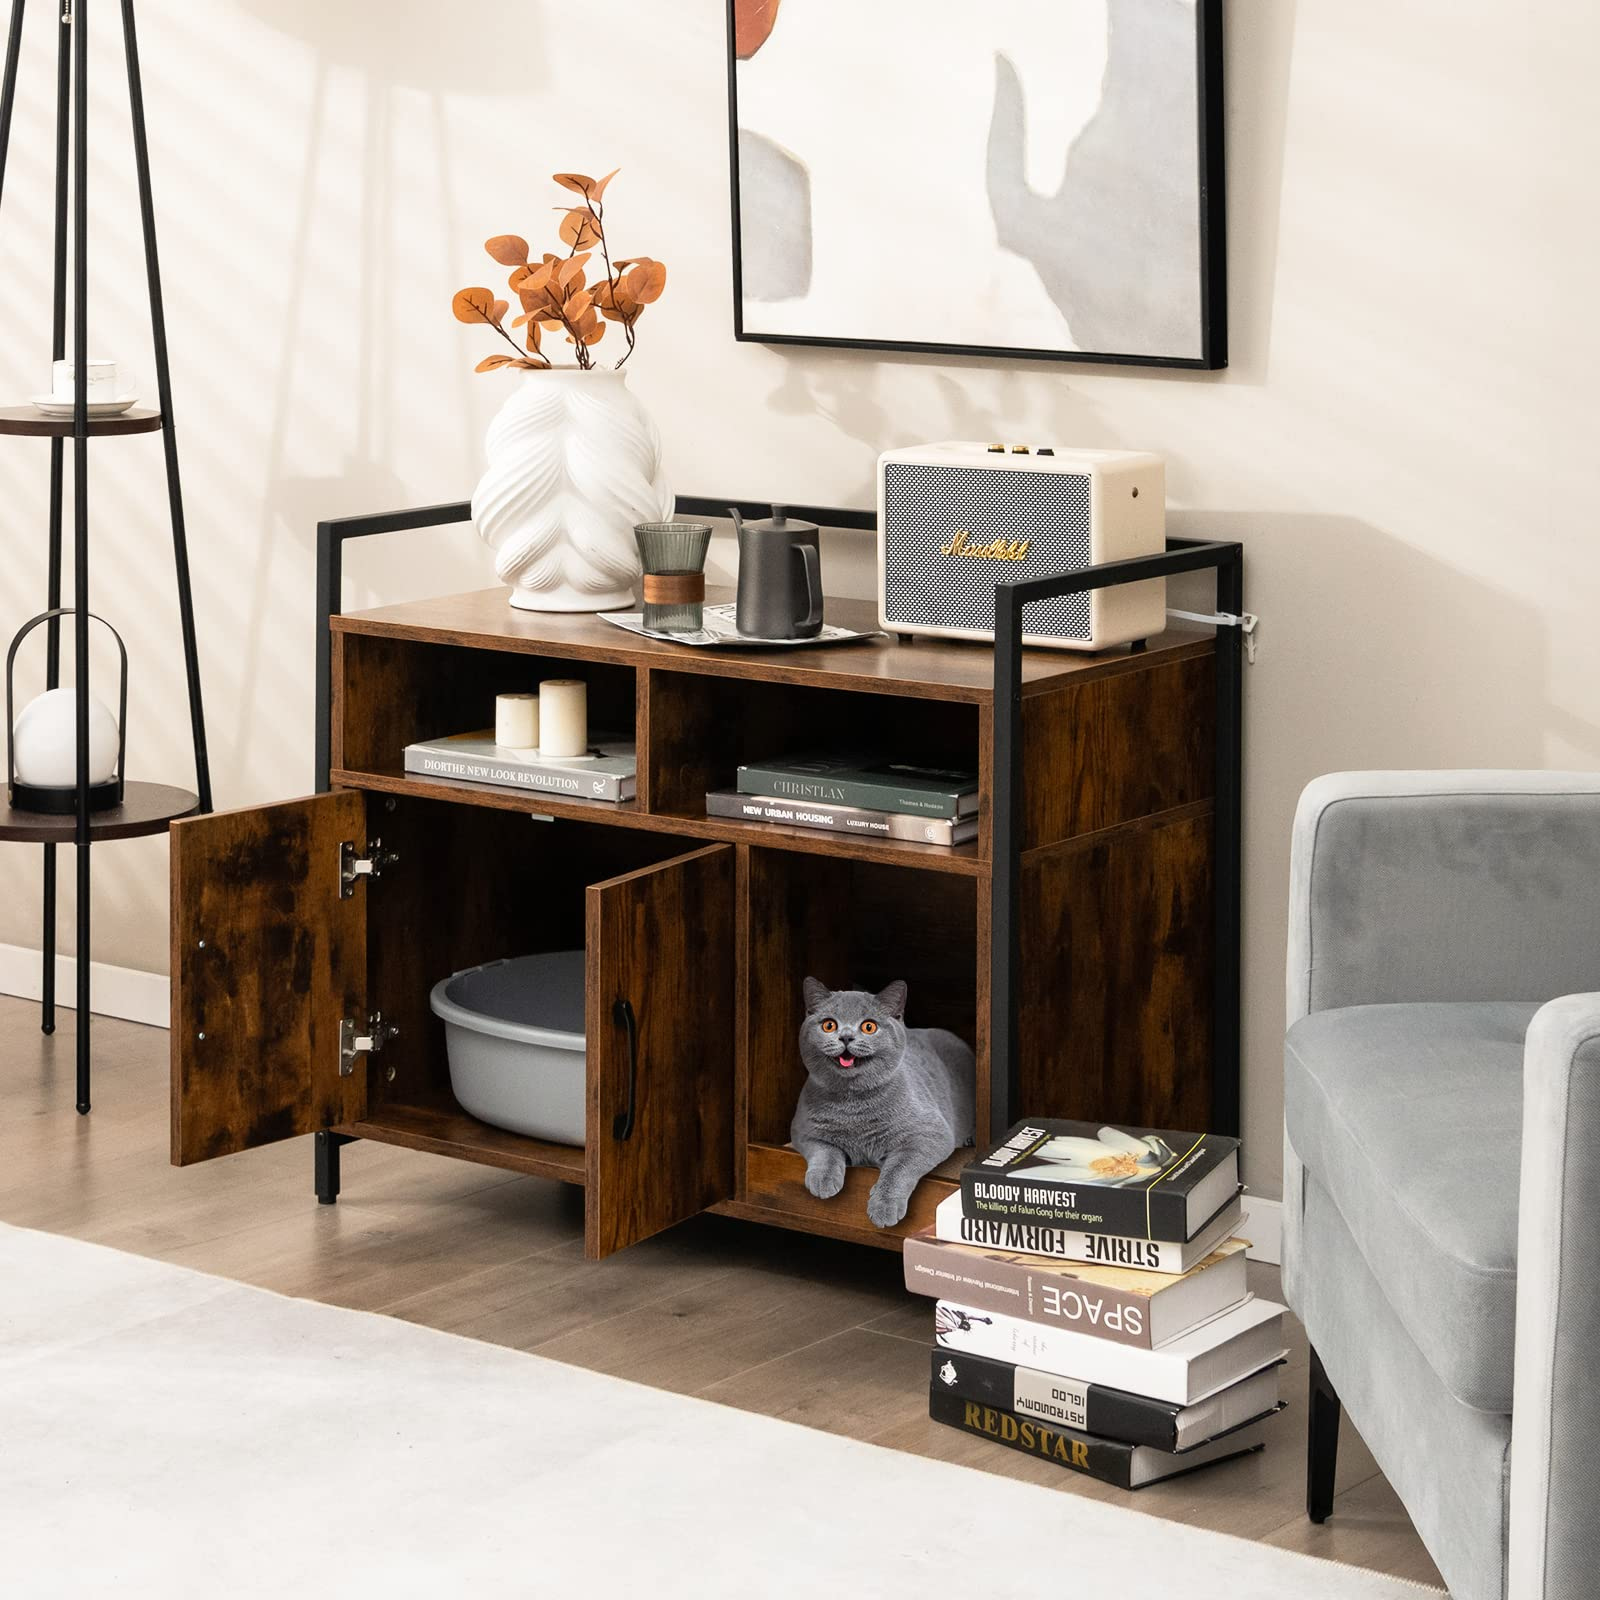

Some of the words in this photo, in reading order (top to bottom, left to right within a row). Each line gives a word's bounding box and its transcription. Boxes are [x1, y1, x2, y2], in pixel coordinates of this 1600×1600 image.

[424, 759, 466, 774] DIORTHE
[467, 765, 489, 777] NEW
[490, 768, 516, 782] LOOK
[517, 774, 579, 790] REVOLUTION
[743, 805, 762, 816] NEW
[765, 808, 793, 820] URBAN
[795, 811, 834, 825] HOUSING
[846, 819, 870, 829] LUXURY
[870, 822, 890, 831] HOUSE
[974, 1182, 1020, 1202] BLOODY
[1024, 1187, 1077, 1208] HARVEST
[976, 1201, 988, 1210] The
[988, 1202, 1008, 1214] killing
[1010, 1204, 1018, 1213] of
[1018, 1204, 1036, 1215] Falun
[1036, 1207, 1053, 1219] Gong
[1054, 1209, 1064, 1219] for
[1064, 1210, 1080, 1220] their
[1081, 1213, 1103, 1224] organs
[960, 1216, 1066, 1255] FORWARD
[1085, 1233, 1160, 1268] STRIVE
[914, 1264, 935, 1276] Design
[935, 1270, 955, 1281] Interior
[962, 1277, 984, 1288] Review
[985, 1282, 1020, 1297] International
[1042, 1285, 1143, 1336] SPACE
[1051, 1388, 1085, 1407] IGLOO
[1016, 1396, 1085, 1425] ASTRONOMY
[964, 1400, 1090, 1470] REDSTAR
